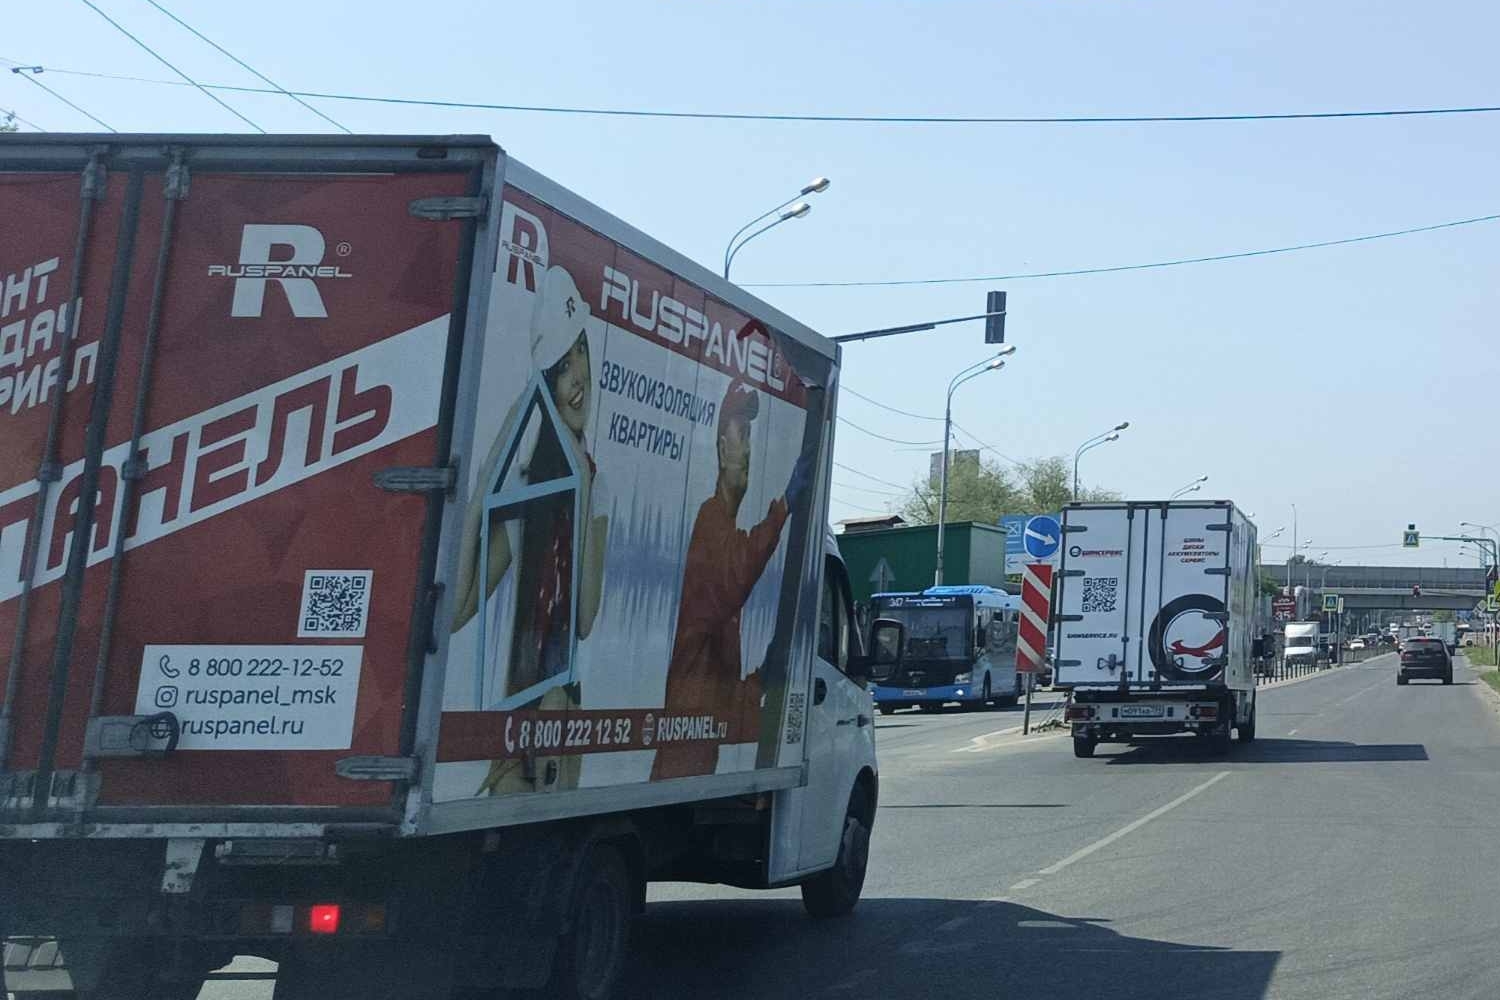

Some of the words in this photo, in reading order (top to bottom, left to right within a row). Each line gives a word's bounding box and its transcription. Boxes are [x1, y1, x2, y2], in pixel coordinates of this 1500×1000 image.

[207, 263, 353, 279] RUSPANEL
[0, 257, 60, 319] НТ
[600, 264, 786, 392] RUSPANEL
[599, 359, 717, 428] ЗВУКОИЗОЛЯЦИЯ
[608, 411, 686, 463] КВАРТИРЫ
[187, 658, 201, 676] 8
[206, 658, 243, 677] 800
[247, 658, 344, 677] 222-12-52
[185, 684, 337, 706] ruspanel_msk
[181, 715, 304, 738] ruspanel.ru
[534, 720, 562, 749] 800
[565, 719, 592, 747] 222
[595, 718, 611, 745] 12
[613, 718, 632, 744] 52
[656, 715, 728, 742] RUSPANEL.ru
